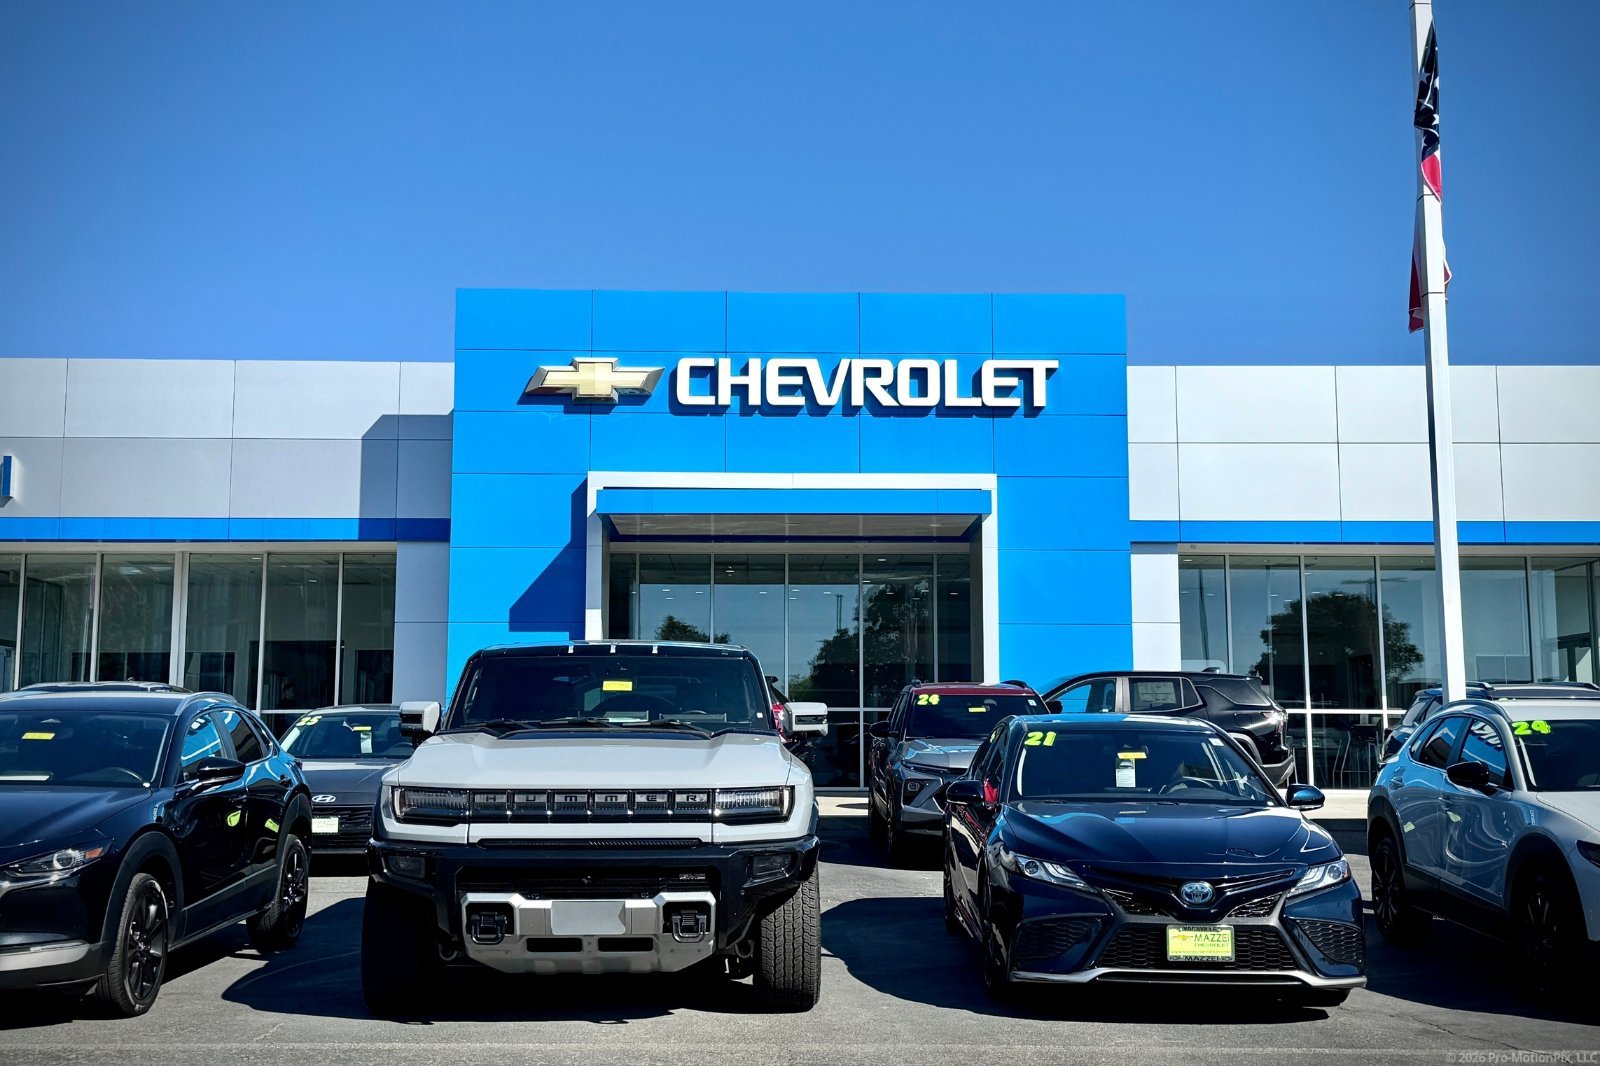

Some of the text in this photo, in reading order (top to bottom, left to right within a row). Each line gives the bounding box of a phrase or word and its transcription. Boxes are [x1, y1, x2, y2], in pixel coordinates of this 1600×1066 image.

[676, 358, 1059, 407] CHEVROLET
[917, 694, 940, 706] 24
[296, 715, 322, 727] 25
[1024, 731, 1057, 747] 21
[485, 794, 698, 802] HUMMER
[1194, 933, 1230, 942] MAZZEI
